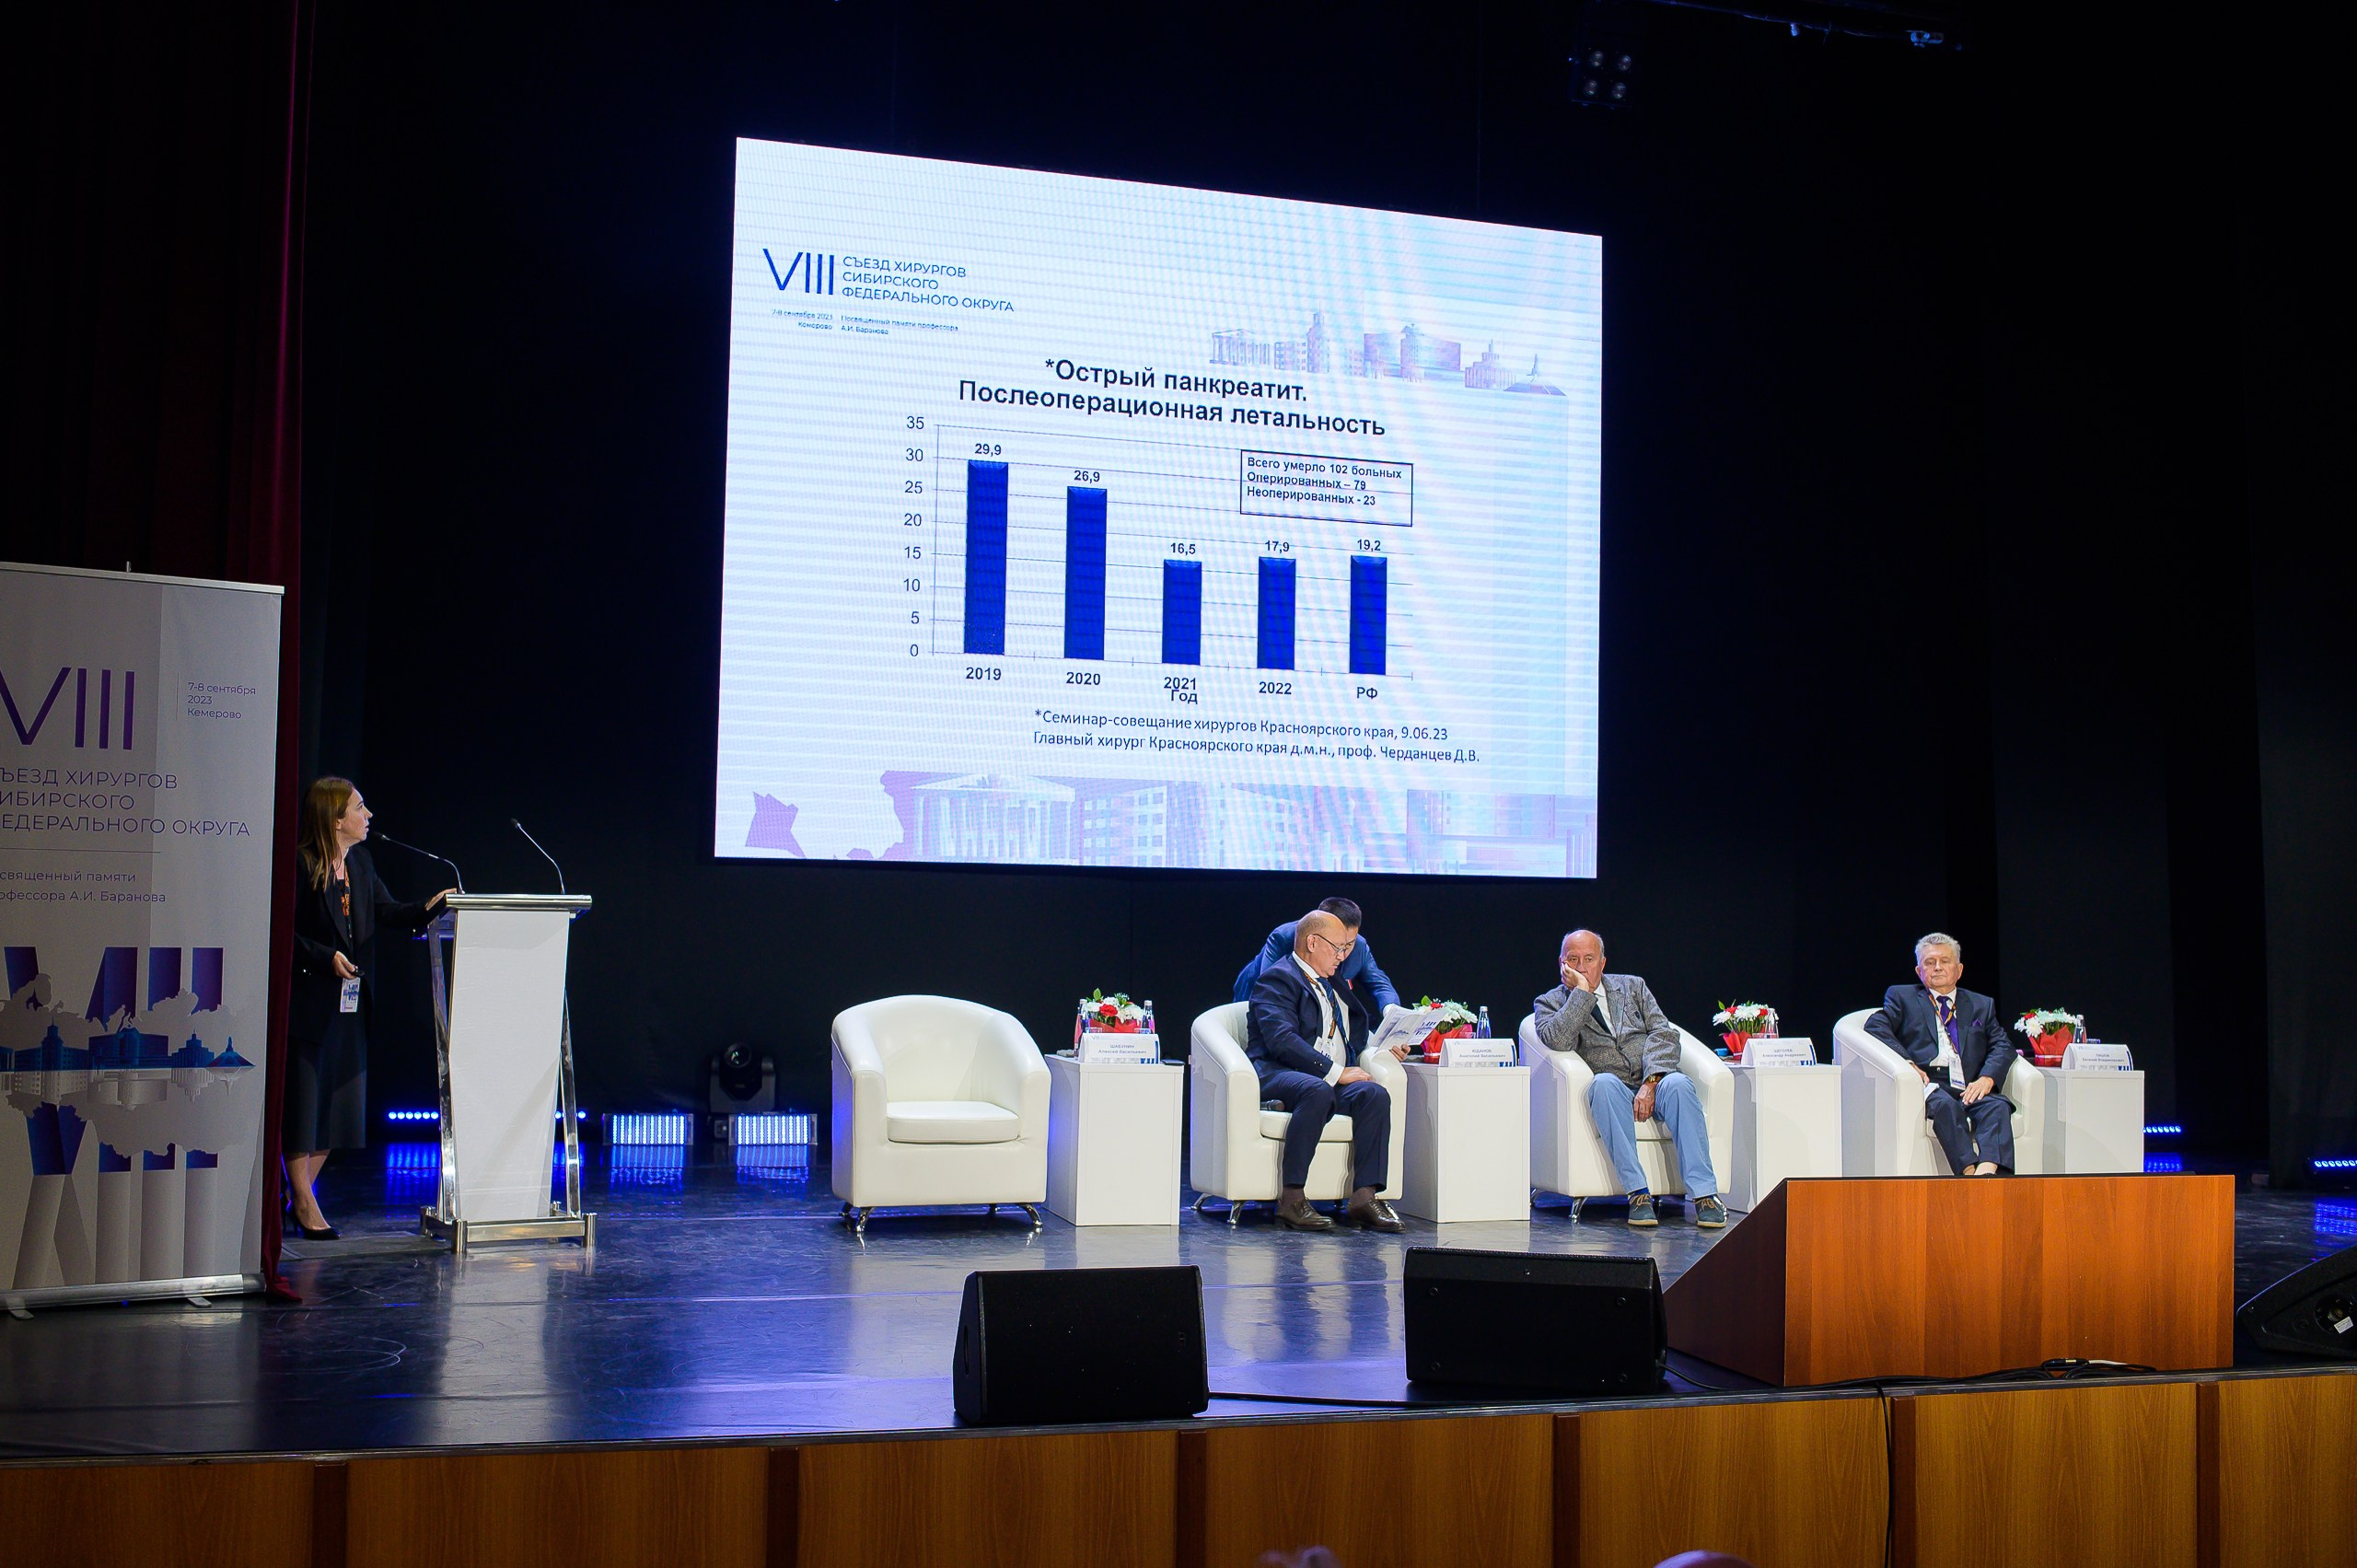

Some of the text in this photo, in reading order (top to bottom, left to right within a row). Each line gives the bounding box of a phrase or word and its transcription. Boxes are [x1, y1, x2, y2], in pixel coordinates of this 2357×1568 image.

[762, 248, 835, 296] VIII
[842, 256, 967, 278] СЪЕЗД ХИРУРГОВ
[842, 272, 939, 290] СИБИРСКОГО
[842, 286, 1015, 313] ФЕДЕРАЛЬНОГО ОКРУГА
[1164, 373, 1306, 401] панкреатит.
[959, 379, 1386, 436] Послеоперационная летальность
[906, 415, 924, 430] 35
[905, 448, 923, 462] 30
[974, 443, 1002, 457] 29,9
[1248, 457, 1402, 479] Всего умерло 102 больных
[1074, 470, 1100, 484] 26,9
[1247, 471, 1341, 491] Оперированных
[1353, 480, 1366, 491] 79
[904, 481, 923, 494] 25
[1247, 486, 1354, 505] Неоперированных
[1363, 495, 1376, 505] 23
[903, 513, 923, 527] 20
[904, 545, 922, 559] 15
[1170, 542, 1196, 555] 16,5
[1264, 540, 1290, 554] 17,9
[1357, 539, 1381, 552] 19,2
[903, 578, 921, 592] 10
[911, 611, 920, 624] 5
[910, 644, 919, 657] 0
[965, 667, 1002, 681] 2019
[1066, 672, 1101, 686] 2020
[188, 681, 256, 696] 7-8 сентября
[1164, 677, 1198, 690] 2021
[1259, 681, 1292, 695] 2022
[187, 694, 213, 705] 2023
[1170, 689, 1198, 704] Год
[1356, 686, 1378, 700] РФ
[0, 667, 135, 750] VIII
[187, 707, 242, 720] Кемерово
[1193, 719, 1257, 733] хирургов
[1260, 719, 1361, 737] Красноярского
[1364, 726, 1398, 739] края,
[1400, 726, 1448, 740] 9.06.23
[1034, 731, 1480, 764] Главный хирург Красноярского края д.м.н., проф. Черданцев Д.В.
[0, 767, 178, 789] ЪЕЗД ХИРУРГОВ
[0, 790, 135, 810] ИБИРСКОГО
[2, 814, 250, 837] ЕДЕРАЛЬНОГО ОКРУГА
[0, 870, 136, 883] священный памяти
[0, 889, 166, 905] офессора А.И. Баранова
